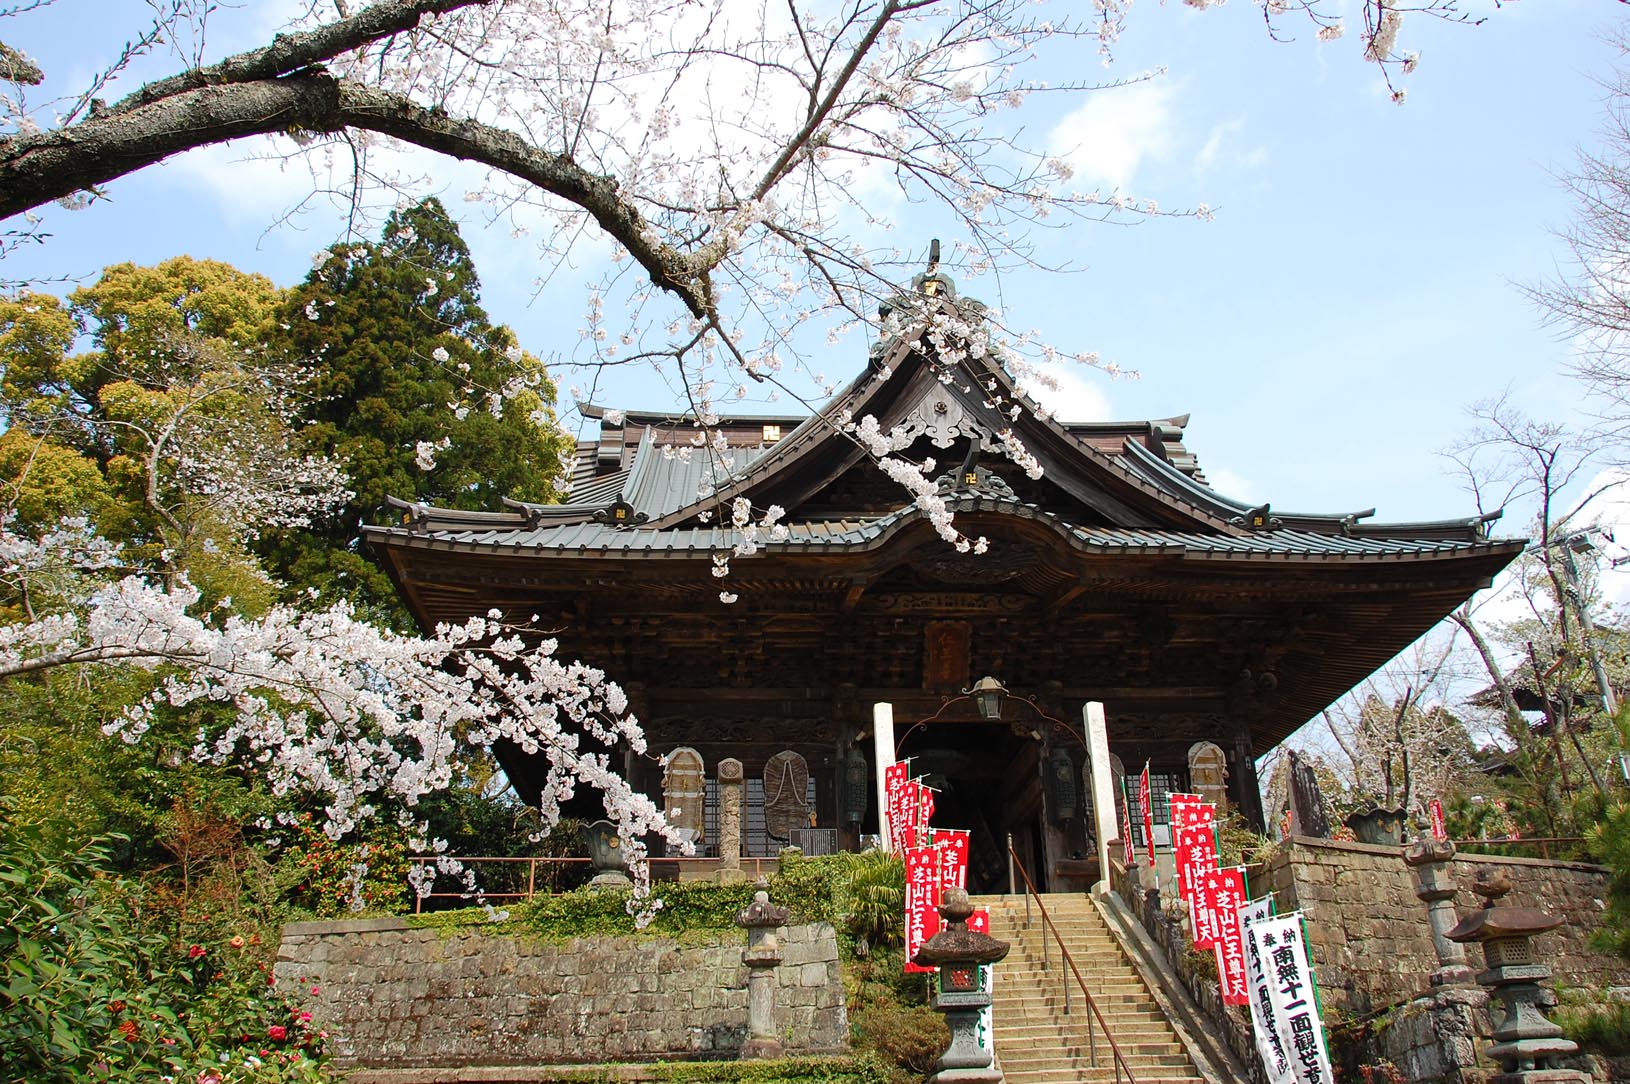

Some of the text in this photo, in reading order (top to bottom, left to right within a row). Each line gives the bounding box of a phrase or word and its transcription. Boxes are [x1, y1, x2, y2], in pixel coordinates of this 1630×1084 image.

[1190, 846, 1213, 942] 芝山仁王尊天
[1263, 928, 1297, 948] 奉納
[1216, 890, 1248, 997] 芝山仁王尊天
